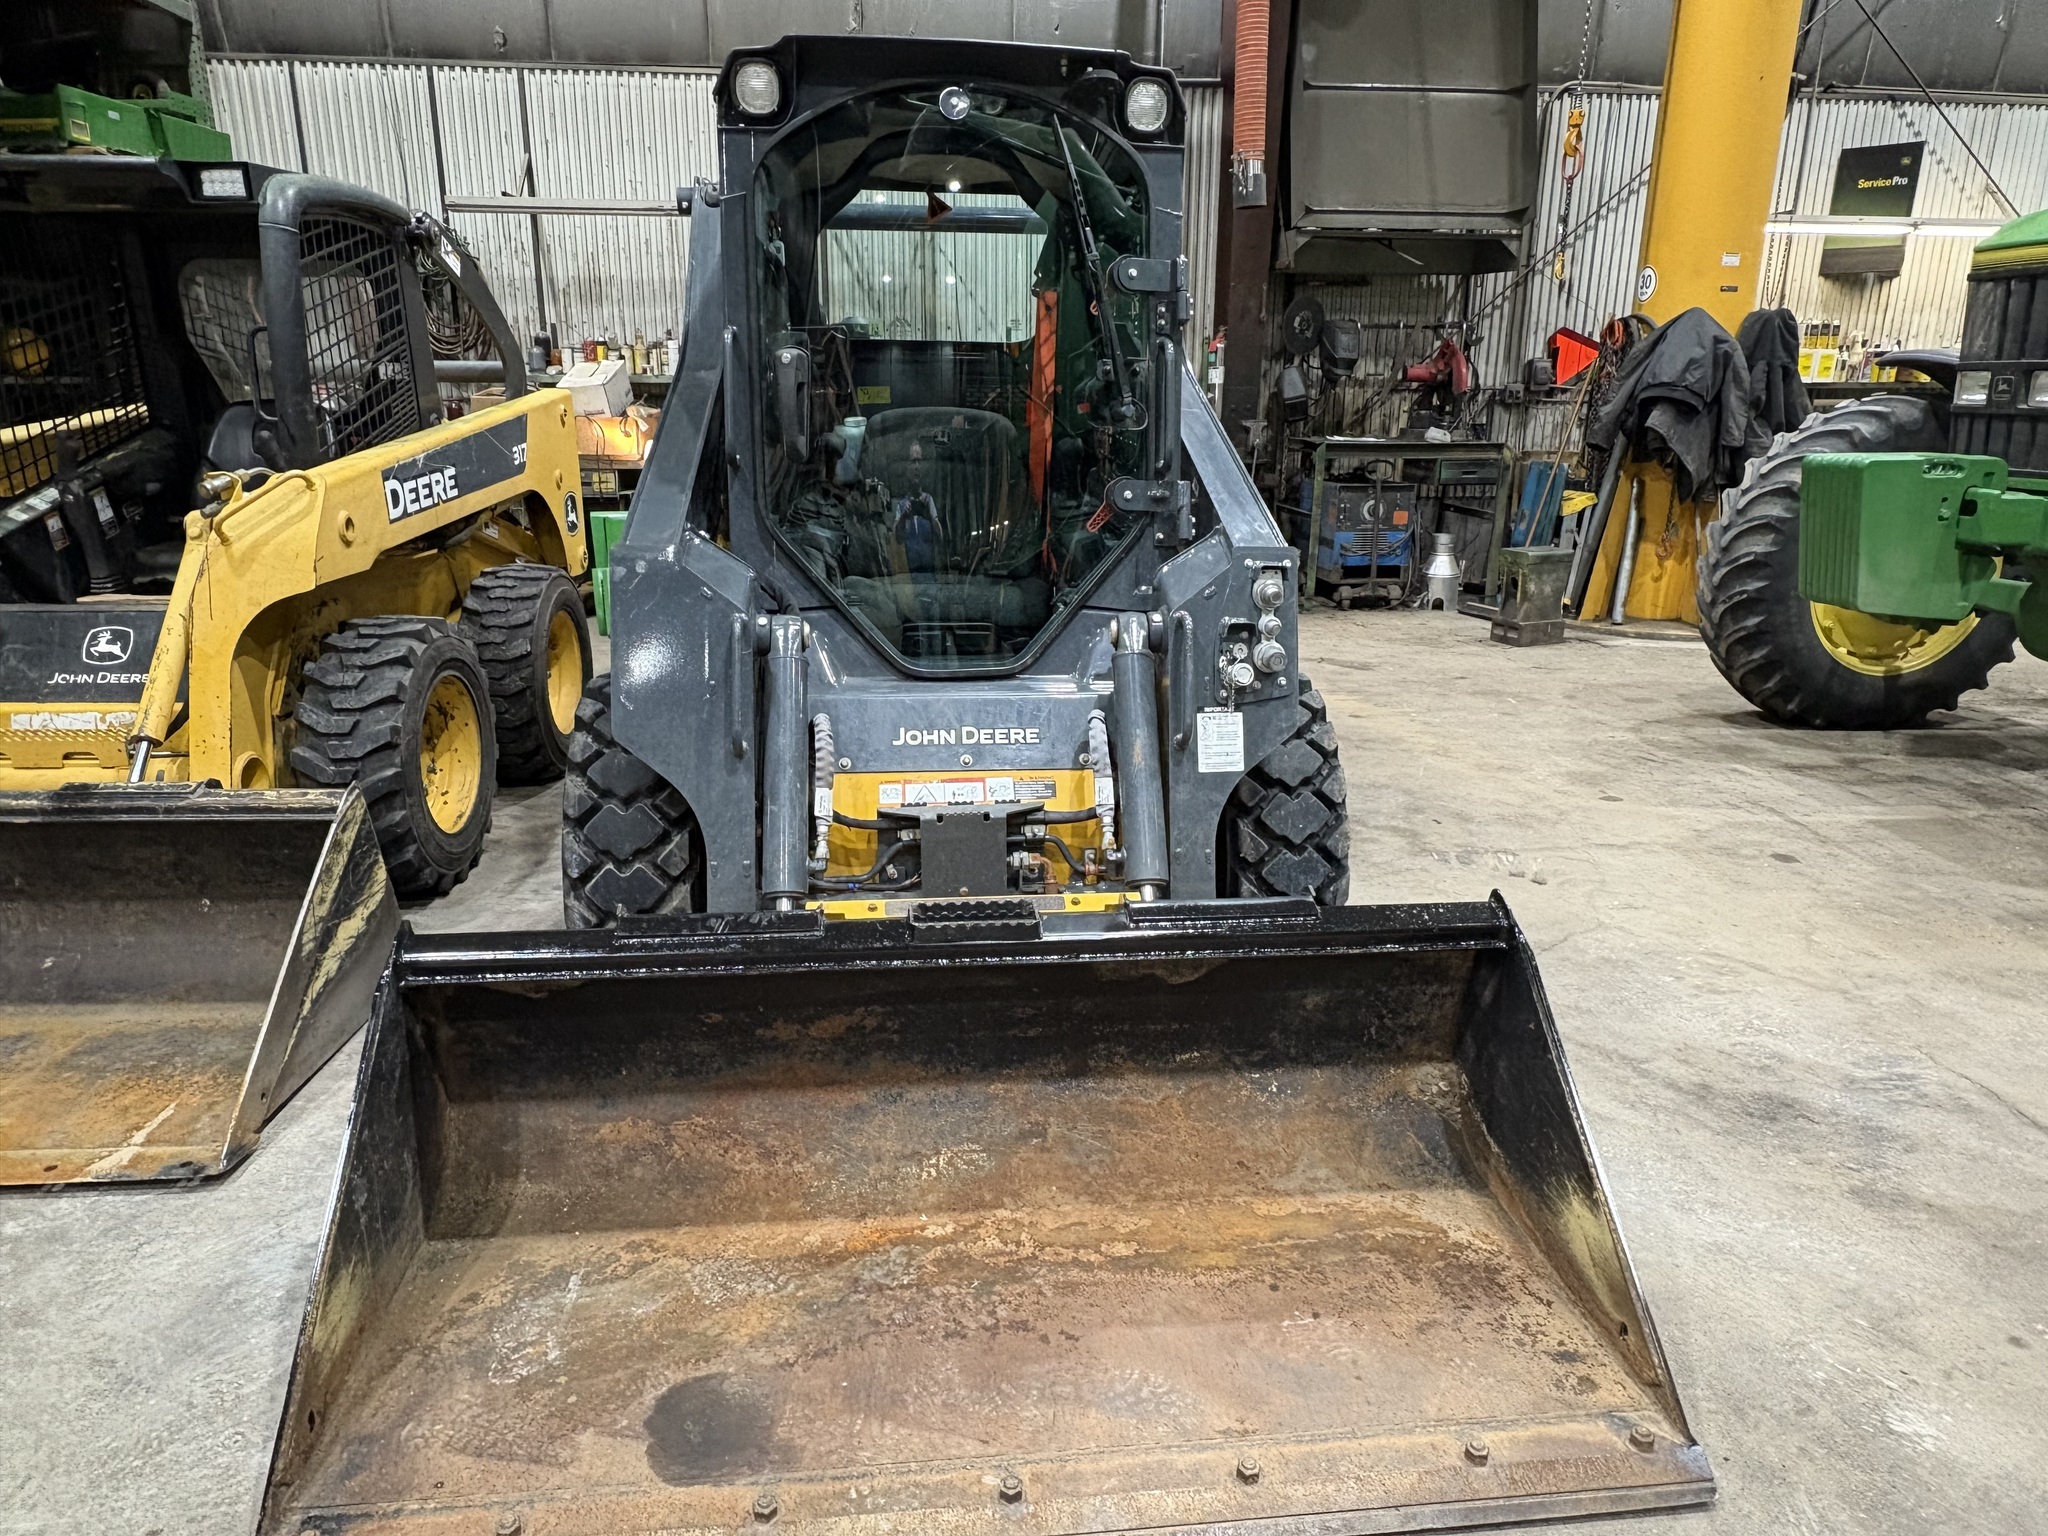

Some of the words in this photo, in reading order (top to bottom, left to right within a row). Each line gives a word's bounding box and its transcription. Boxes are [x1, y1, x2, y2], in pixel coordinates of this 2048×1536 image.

[1640, 274, 1652, 290] 30
[512, 443, 527, 466] 317
[384, 467, 458, 520] DEERE
[47, 672, 94, 684] JOHN
[892, 727, 956, 745] JOHN
[961, 726, 1040, 744] DEERE
